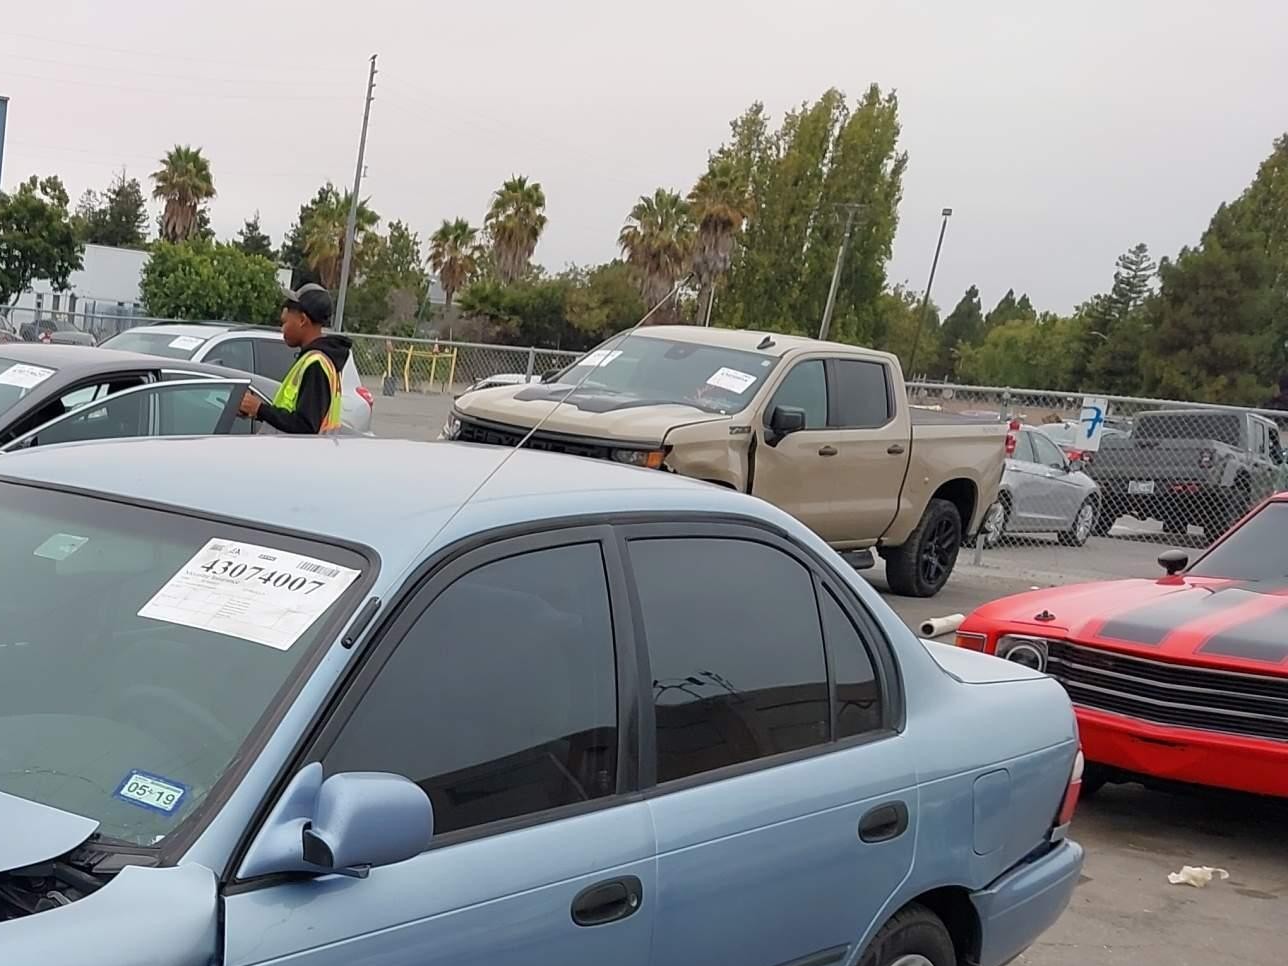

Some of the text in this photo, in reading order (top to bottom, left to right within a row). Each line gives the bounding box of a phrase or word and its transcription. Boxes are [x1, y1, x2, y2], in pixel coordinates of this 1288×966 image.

[1081, 406, 1103, 438] 7
[201, 559, 325, 595] 43074007
[127, 782, 149, 796] 05
[155, 791, 175, 805] 19
